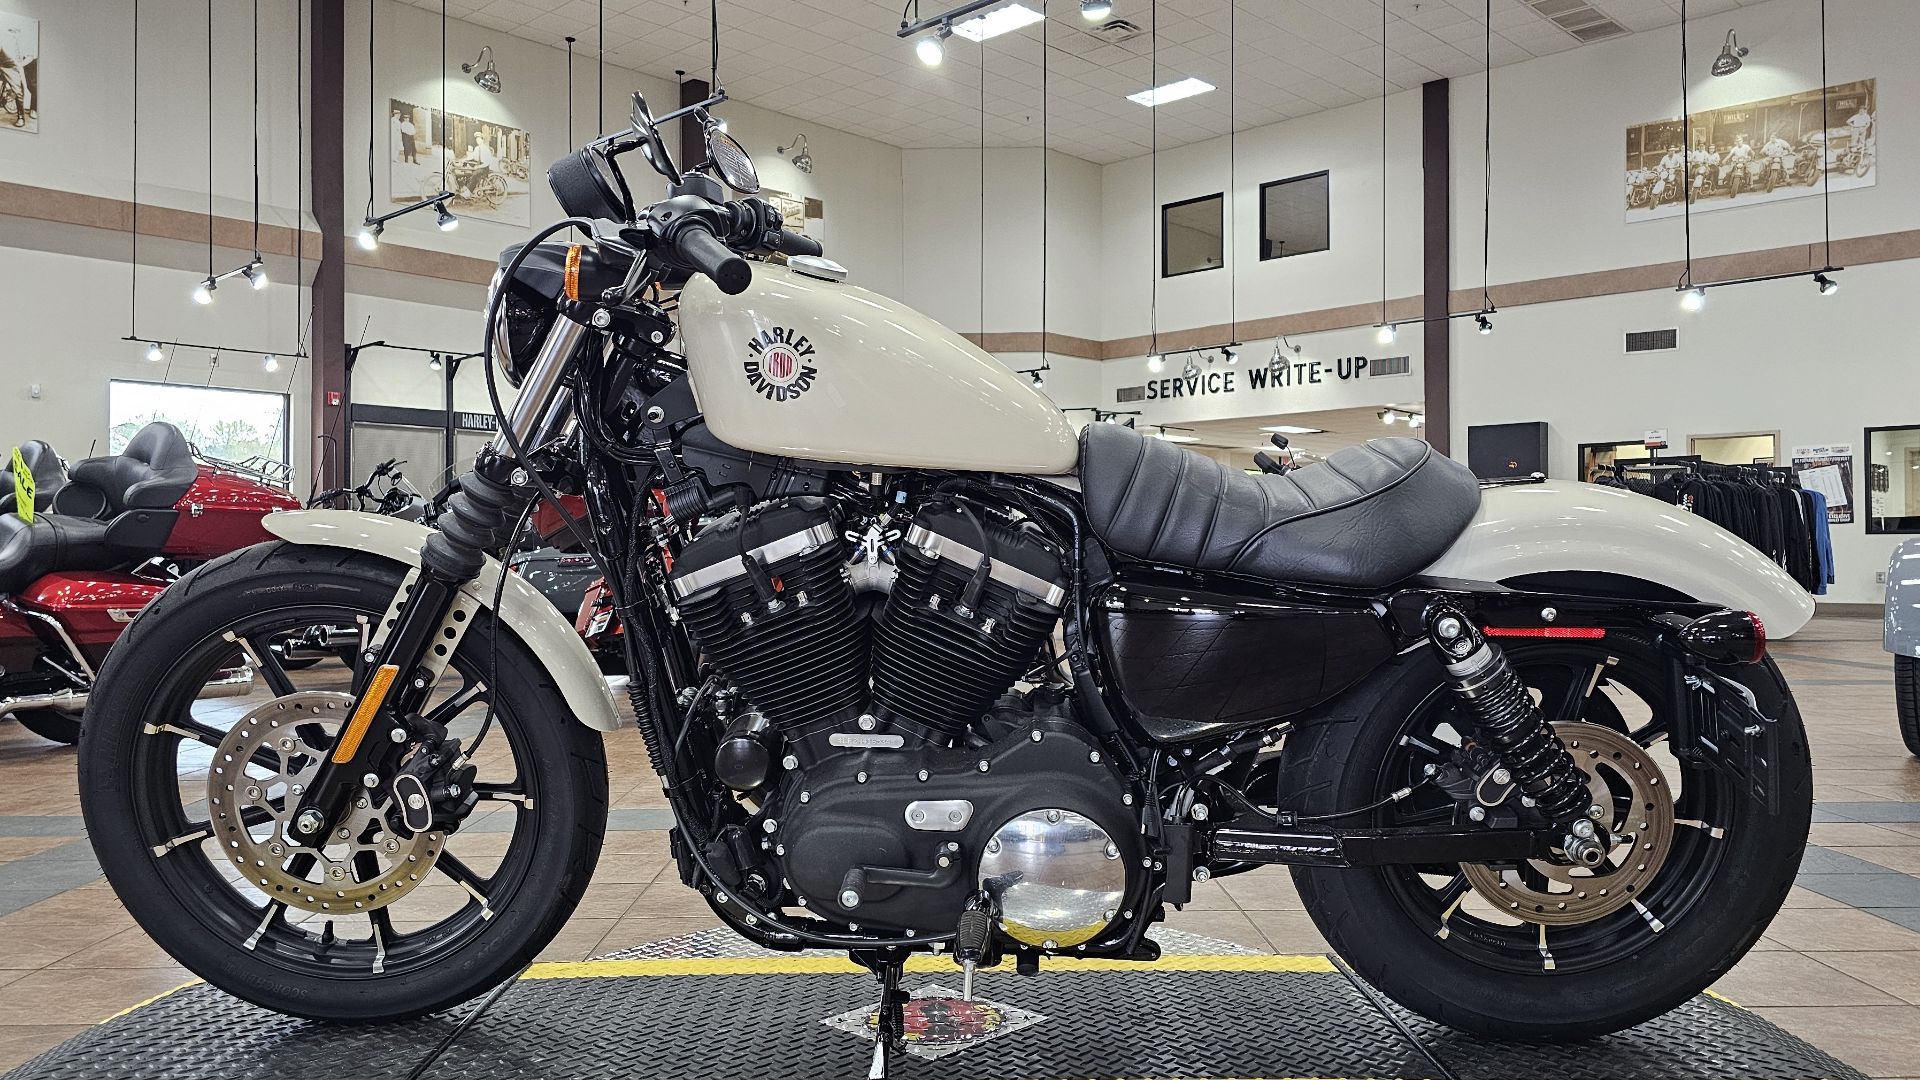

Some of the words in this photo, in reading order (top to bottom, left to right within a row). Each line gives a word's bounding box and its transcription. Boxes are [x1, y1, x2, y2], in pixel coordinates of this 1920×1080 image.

[748, 326, 816, 357] HARLEY
[743, 361, 818, 402] DAVIDSON
[768, 352, 793, 378] IRON
[1146, 371, 1235, 400] SERVICE
[1248, 356, 1368, 390] WRITE-UP
